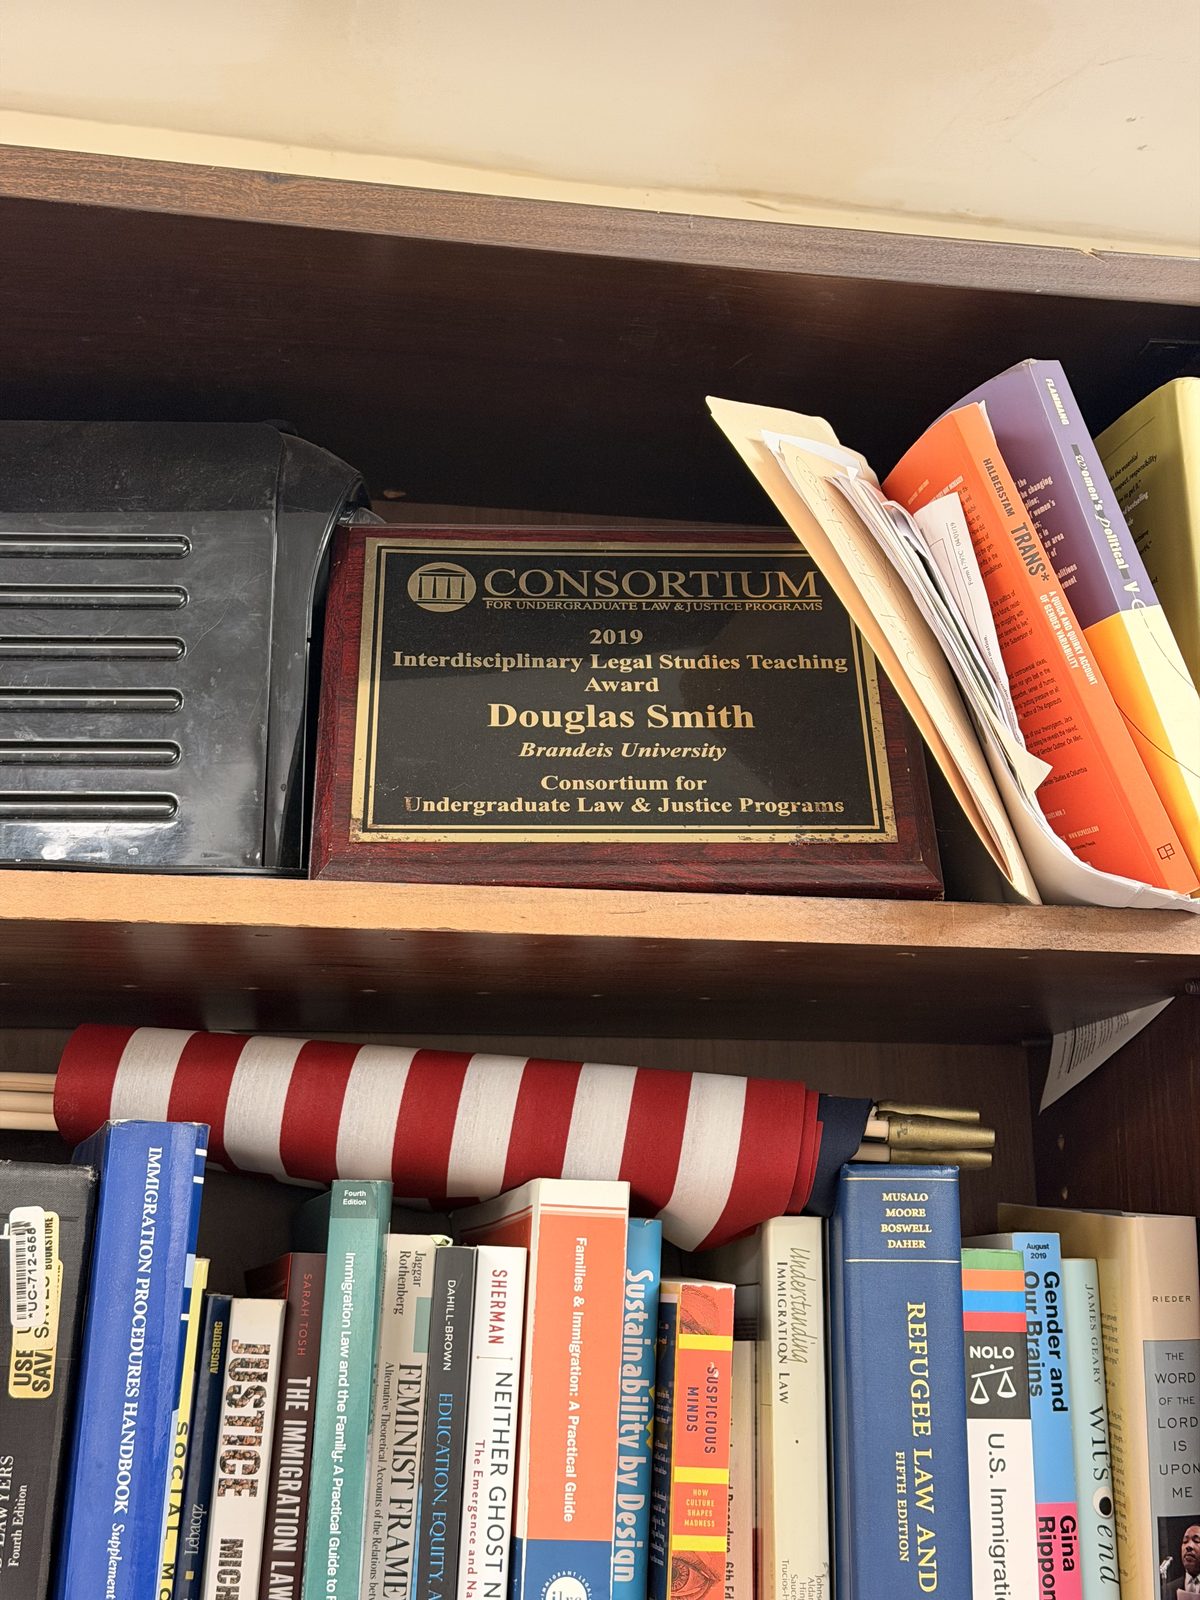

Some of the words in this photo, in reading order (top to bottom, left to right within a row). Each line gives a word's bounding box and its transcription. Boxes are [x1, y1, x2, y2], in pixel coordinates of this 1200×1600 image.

[983, 458, 1015, 517] HALBERSTAM
[1026, 474, 1054, 495] changing
[483, 569, 819, 599] CONSORTIUM
[1040, 594, 1050, 604] OF
[486, 601, 513, 610] FOR
[516, 601, 638, 611] UNDERGRADUATE
[642, 602, 671, 611] LAW
[744, 602, 823, 611] PROGRAMS
[1044, 605, 1060, 631] GENDER
[1052, 596, 1067, 616] QUICK
[1062, 616, 1072, 631] AND
[589, 629, 644, 645] 2019
[1056, 629, 1080, 669] VARIABILITY
[1066, 630, 1084, 655] QUIRKY
[392, 650, 583, 672] Interdisciplinary
[590, 654, 653, 673] Legal
[659, 654, 741, 670] Studies
[746, 654, 848, 673] Teaching
[1078, 652, 1098, 686] ACCOUNT
[583, 677, 660, 692] Award
[487, 703, 635, 735] Douglas
[646, 704, 756, 729] Smith
[518, 742, 614, 758] Brandeis
[621, 742, 727, 762] University
[540, 774, 671, 792] Consortium
[675, 775, 707, 791] for
[404, 796, 571, 816] Undergraduate
[577, 797, 629, 813] Law
[632, 797, 652, 813] &
[657, 797, 733, 813] Justice
[738, 798, 846, 817] Programs
[137, 1146, 163, 1274] IMMIGRATION
[882, 1192, 929, 1201] MUSALO
[885, 1208, 926, 1217] MOORE
[881, 1224, 932, 1233] BOSWELL
[887, 1240, 926, 1248] DAHER
[1026, 1243, 1050, 1251] August
[412, 1251, 427, 1288] Jaggar
[573, 1237, 588, 1293] Families
[1030, 1252, 1047, 1260] 2019
[302, 1273, 313, 1317] SARAH
[340, 1252, 356, 1328] Immigration
[393, 1250, 412, 1316] Rothenberg
[573, 1296, 585, 1308] &
[1024, 1271, 1040, 1315] Our
[443, 1280, 456, 1371] DAHILL-BROWN
[488, 1269, 508, 1344] SHERMAN
[789, 1247, 818, 1364] Understanding
[1044, 1271, 1063, 1360] Gender
[1085, 1284, 1097, 1331] JAMES
[125, 1277, 151, 1398] PROCEDURES
[209, 1321, 224, 1374] AUGSBURG
[297, 1321, 309, 1356] TOSH
[339, 1331, 352, 1358] Law
[568, 1312, 584, 1397] Immigration:
[969, 1346, 1015, 1359] NOLO
[1166, 1353, 1184, 1361] THE
[13, 1349, 34, 1386] USE
[337, 1360, 350, 1387] and
[617, 1269, 654, 1449] Sustainability
[906, 1302, 933, 1437] REFUGEE
[1026, 1320, 1045, 1397] Brains
[1090, 1337, 1101, 1385] GEARY
[1155, 1372, 1196, 1384] WORD
[284, 1376, 312, 1411] THE
[337, 1390, 349, 1412] the
[382, 1361, 395, 1410] Alternative
[1050, 1368, 1068, 1412] and
[1158, 1397, 1173, 1406] OF
[1176, 1396, 1195, 1405] THE
[217, 1339, 272, 1497] JUSTICE
[490, 1372, 513, 1476] NEITHER
[568, 1401, 580, 1411] A
[686, 1386, 699, 1432] MINDS
[704, 1366, 719, 1454] SUSPICIOUS
[1158, 1417, 1199, 1429] LORD
[331, 1415, 348, 1463] Family:
[378, 1412, 391, 1463] Theoretical
[390, 1364, 423, 1490] FEMINIST
[565, 1415, 580, 1478] Practical
[1173, 1440, 1187, 1451] IS
[111, 1402, 138, 1515] HANDBOOK
[432, 1393, 453, 1505] EDUCATION,
[473, 1439, 486, 1465] The
[988, 1433, 1006, 1479] U.S.
[165, 1422, 188, 1539] SOCIAL
[272, 1420, 307, 1552] IMMIGRATION
[333, 1465, 345, 1475] A
[374, 1465, 387, 1507] Accounts
[617, 1456, 647, 1487] by
[896, 1451, 907, 1494] FIFTH
[912, 1448, 935, 1514] LAW
[1159, 1463, 1200, 1476] UPON
[13, 1484, 28, 1526] Edition
[329, 1477, 344, 1534] Practical
[467, 1470, 484, 1545] Emergence
[563, 1482, 577, 1523] Guide
[686, 1498, 715, 1507] CULTURE
[692, 1488, 709, 1496] HOW
[1172, 1487, 1193, 1498] ME
[184, 1504, 208, 1555] Lebacqz
[373, 1520, 384, 1536] the
[374, 1509, 384, 1519] of
[484, 1487, 507, 1572] GHOST
[684, 1520, 715, 1528] MADNESS
[687, 1509, 713, 1517] SHAPES
[897, 1499, 909, 1562] EDITION
[8, 1529, 23, 1567] Fourth
[327, 1537, 340, 1576] Guide
[382, 1496, 414, 1600] FRAME
[428, 1512, 447, 1584] EQUITY,
[613, 1493, 645, 1582] Design
[1060, 1515, 1077, 1571] Gina
[106, 1523, 125, 1600] Supplement
[215, 1538, 244, 1600] MICH
[370, 1537, 382, 1580] Relations
[467, 1550, 478, 1575] and
[916, 1524, 938, 1593] AND
[1037, 1516, 1057, 1600] Rippon
[268, 1561, 296, 1600] LAW
[326, 1579, 338, 1593] to
